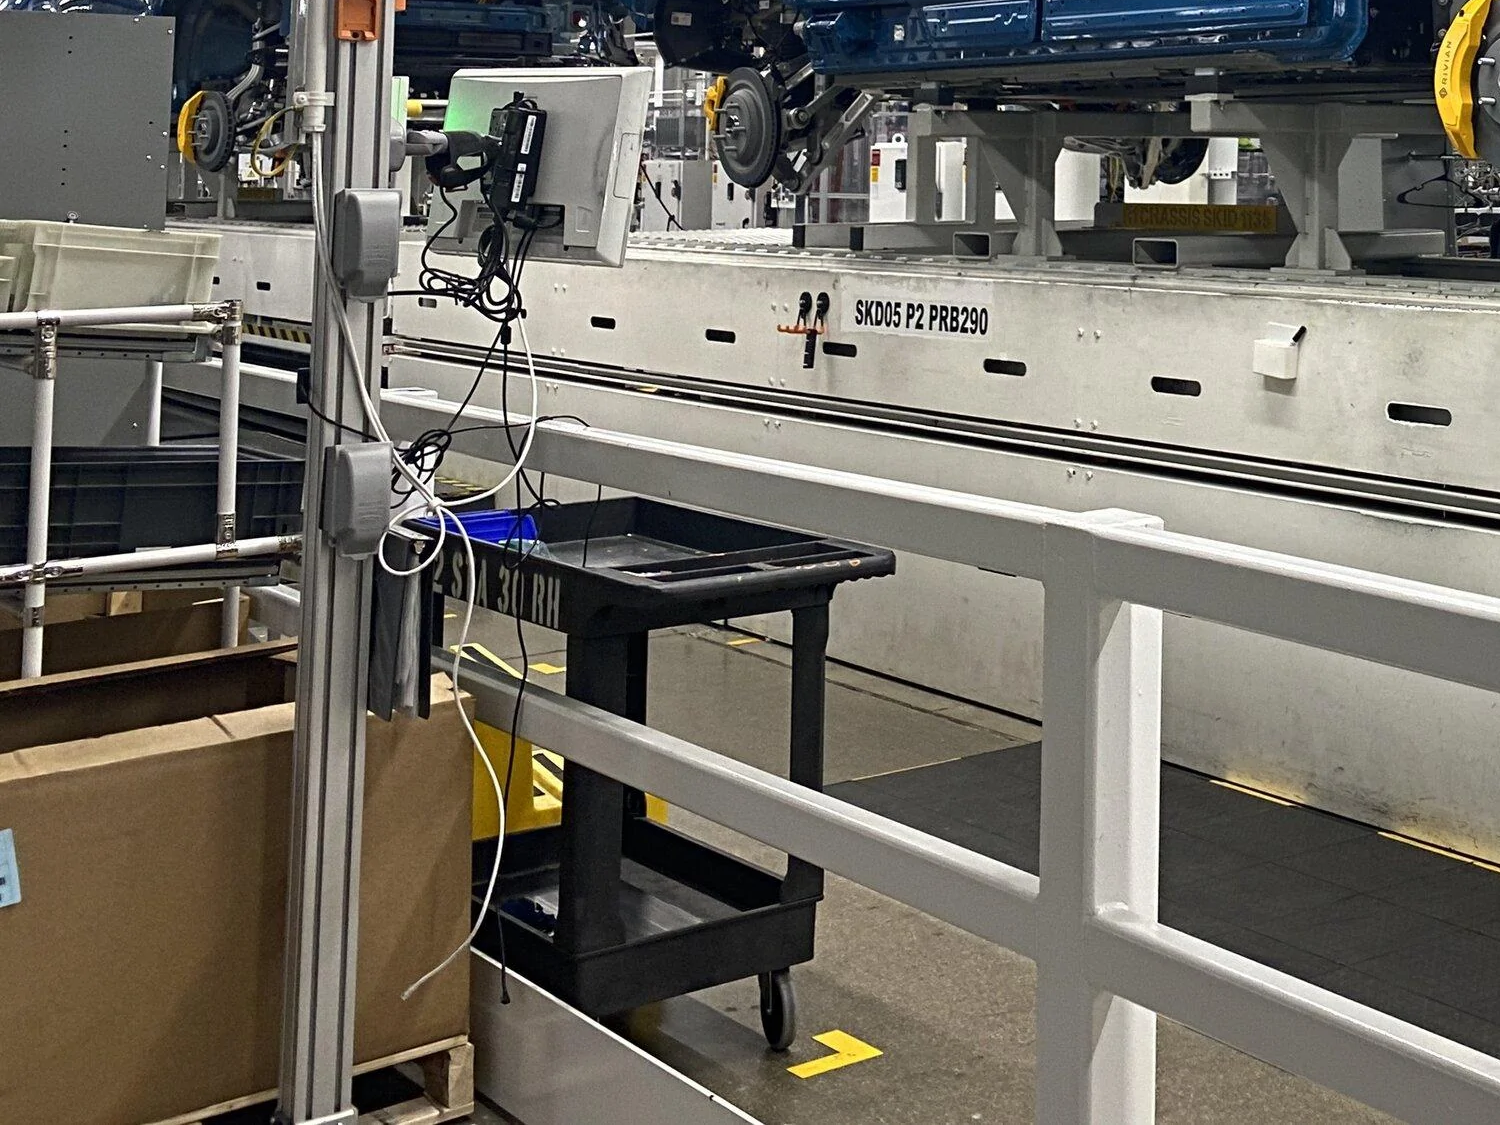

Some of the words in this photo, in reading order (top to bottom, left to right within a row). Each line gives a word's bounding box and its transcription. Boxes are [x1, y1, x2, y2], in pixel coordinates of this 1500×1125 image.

[1441, 41, 1452, 85] RIVIAN
[855, 299, 902, 328] SKD05
[905, 302, 925, 330] P2
[928, 304, 989, 336] PRB290
[532, 572, 560, 630] RH
